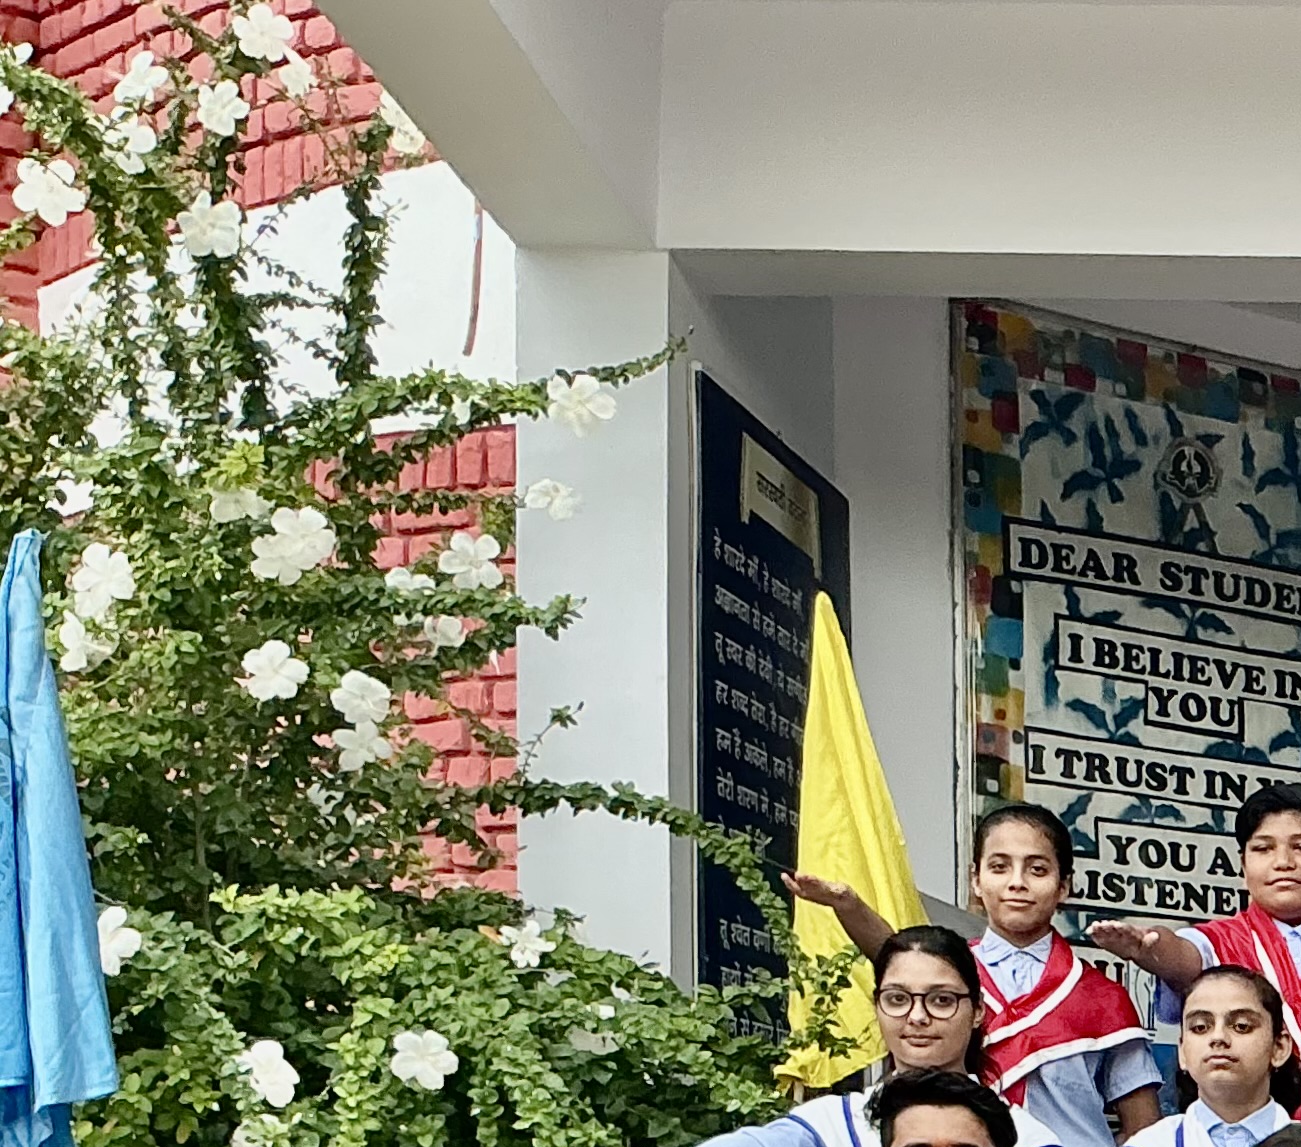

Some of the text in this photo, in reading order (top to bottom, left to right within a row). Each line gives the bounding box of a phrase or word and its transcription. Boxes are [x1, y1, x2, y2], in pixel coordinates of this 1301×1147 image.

[1018, 536, 1142, 586] DEAR
[1068, 632, 1083, 664] I
[1092, 638, 1266, 696] BELIEVE
[715, 680, 729, 706] हर
[1148, 685, 1237, 727] YOU
[715, 727, 732, 754] हम
[1029, 744, 1047, 775] I
[1055, 747, 1195, 797] TRUST
[1203, 769, 1248, 803] IN
[1106, 834, 1198, 872] YOU
